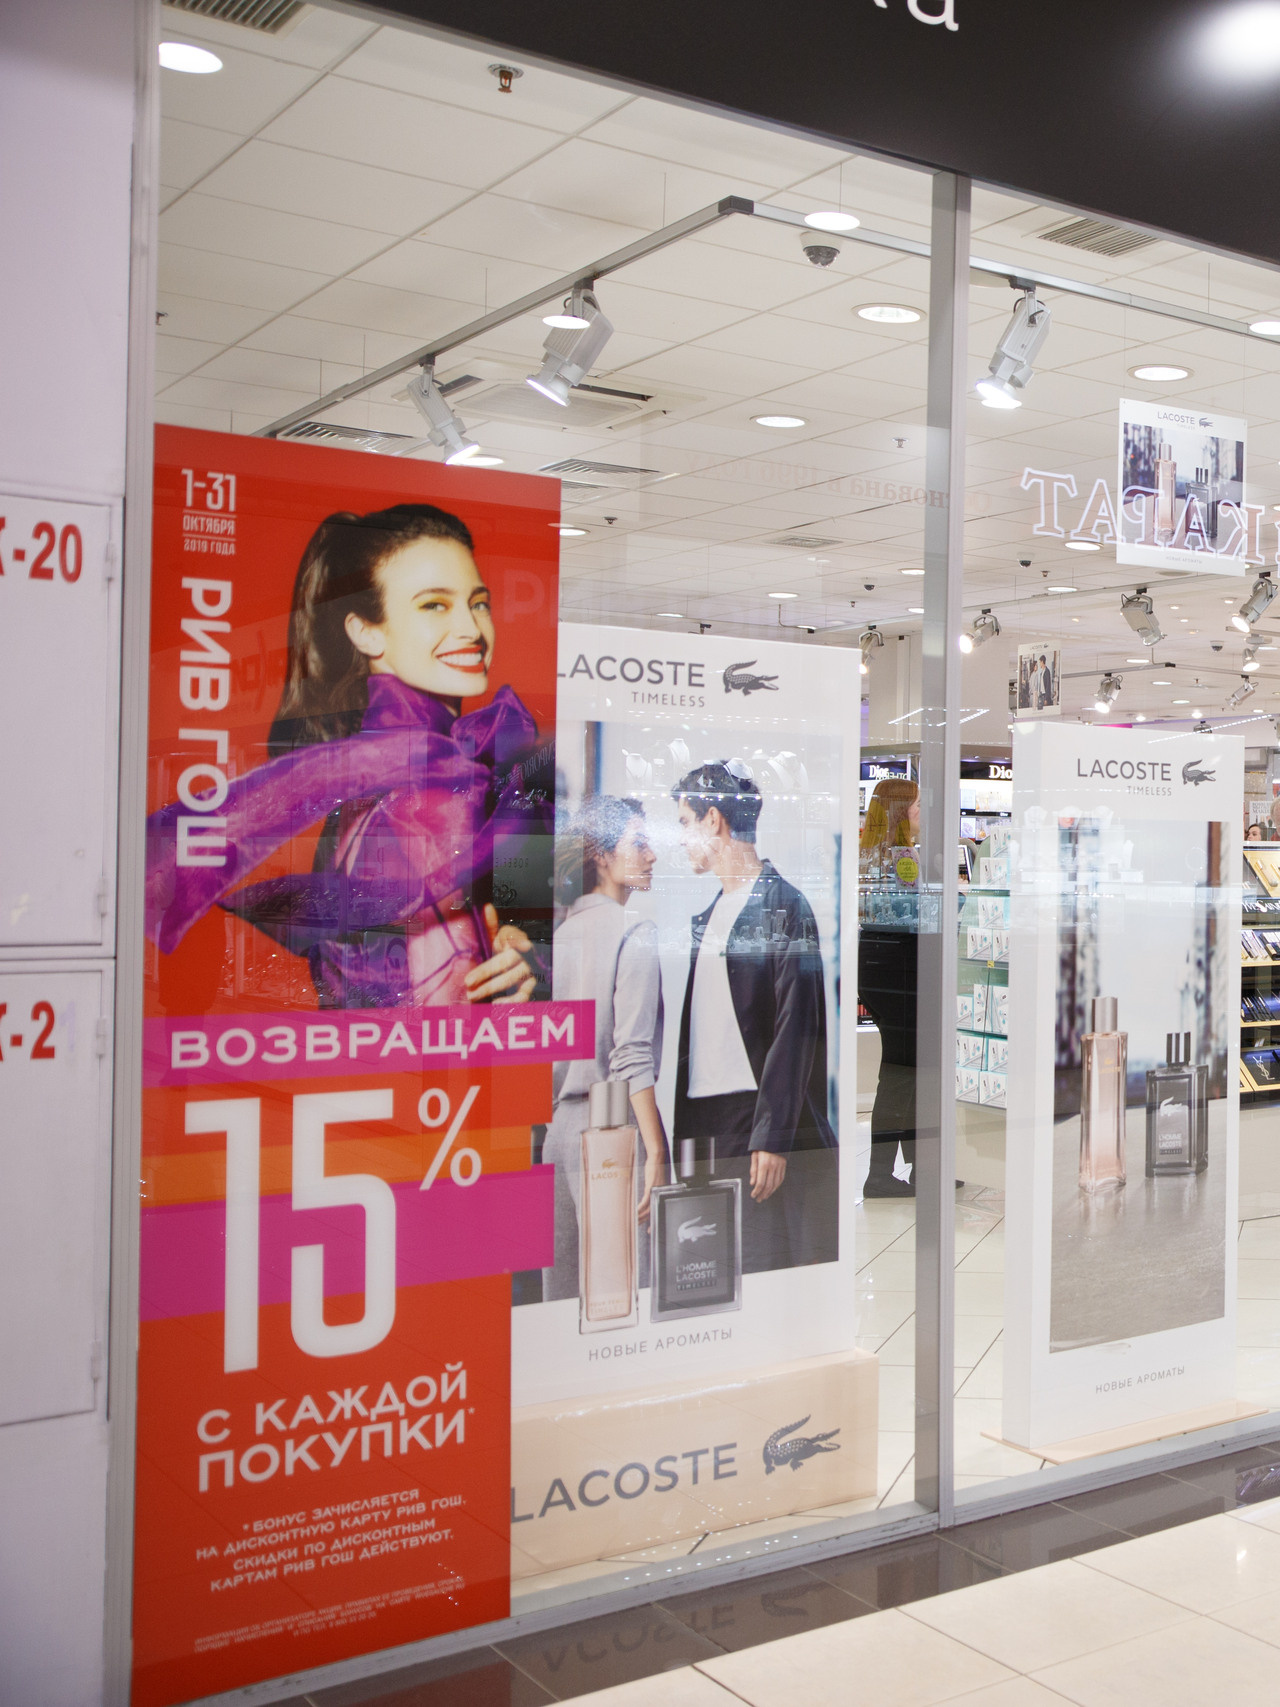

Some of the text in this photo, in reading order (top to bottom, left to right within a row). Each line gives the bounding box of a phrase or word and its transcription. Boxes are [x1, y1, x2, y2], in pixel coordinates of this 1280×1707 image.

[1157, 411, 1195, 425] LACOSTE
[181, 468, 236, 512] 1-31
[182, 515, 235, 535] ОКТЯБРЯ
[0, 517, 83, 583] -20
[183, 538, 236, 556] 2019 ГОДА
[631, 691, 706, 707] TIMELESS
[175, 577, 233, 869] РИВ ГОШ
[988, 764, 1013, 779] Dio
[1077, 758, 1172, 781] LACOSTE
[1127, 785, 1172, 797] TIMELESS
[171, 1013, 576, 1069] ВОЗВРАЩАЕМ
[1158, 1140, 1182, 1148] LACOSTE
[676, 1260, 717, 1273] L'HOMME
[676, 1269, 717, 1283] LACOSTE
[588, 1328, 733, 1361] НОВЫЕ АРОМАТЫ
[1095, 1365, 1185, 1394] НОВЫЕ АРОМАТЫ
[196, 1361, 468, 1444] С КАЖДОЙ
[511, 1442, 738, 1523] LACOSTE
[311, 1489, 420, 1521] ЗАЧИСЛЯЕТСЯ
[196, 1495, 467, 1561] НА ДИСКОНТНУЮ КАРТУ РИВ ГОШ.
[233, 1518, 436, 1571] СКИДКИ ПО ДИСКОНТНЫМ
[210, 1528, 454, 1592] КАРТАМ РИВ ГОШ ДЕЙСТВУЮТ.
